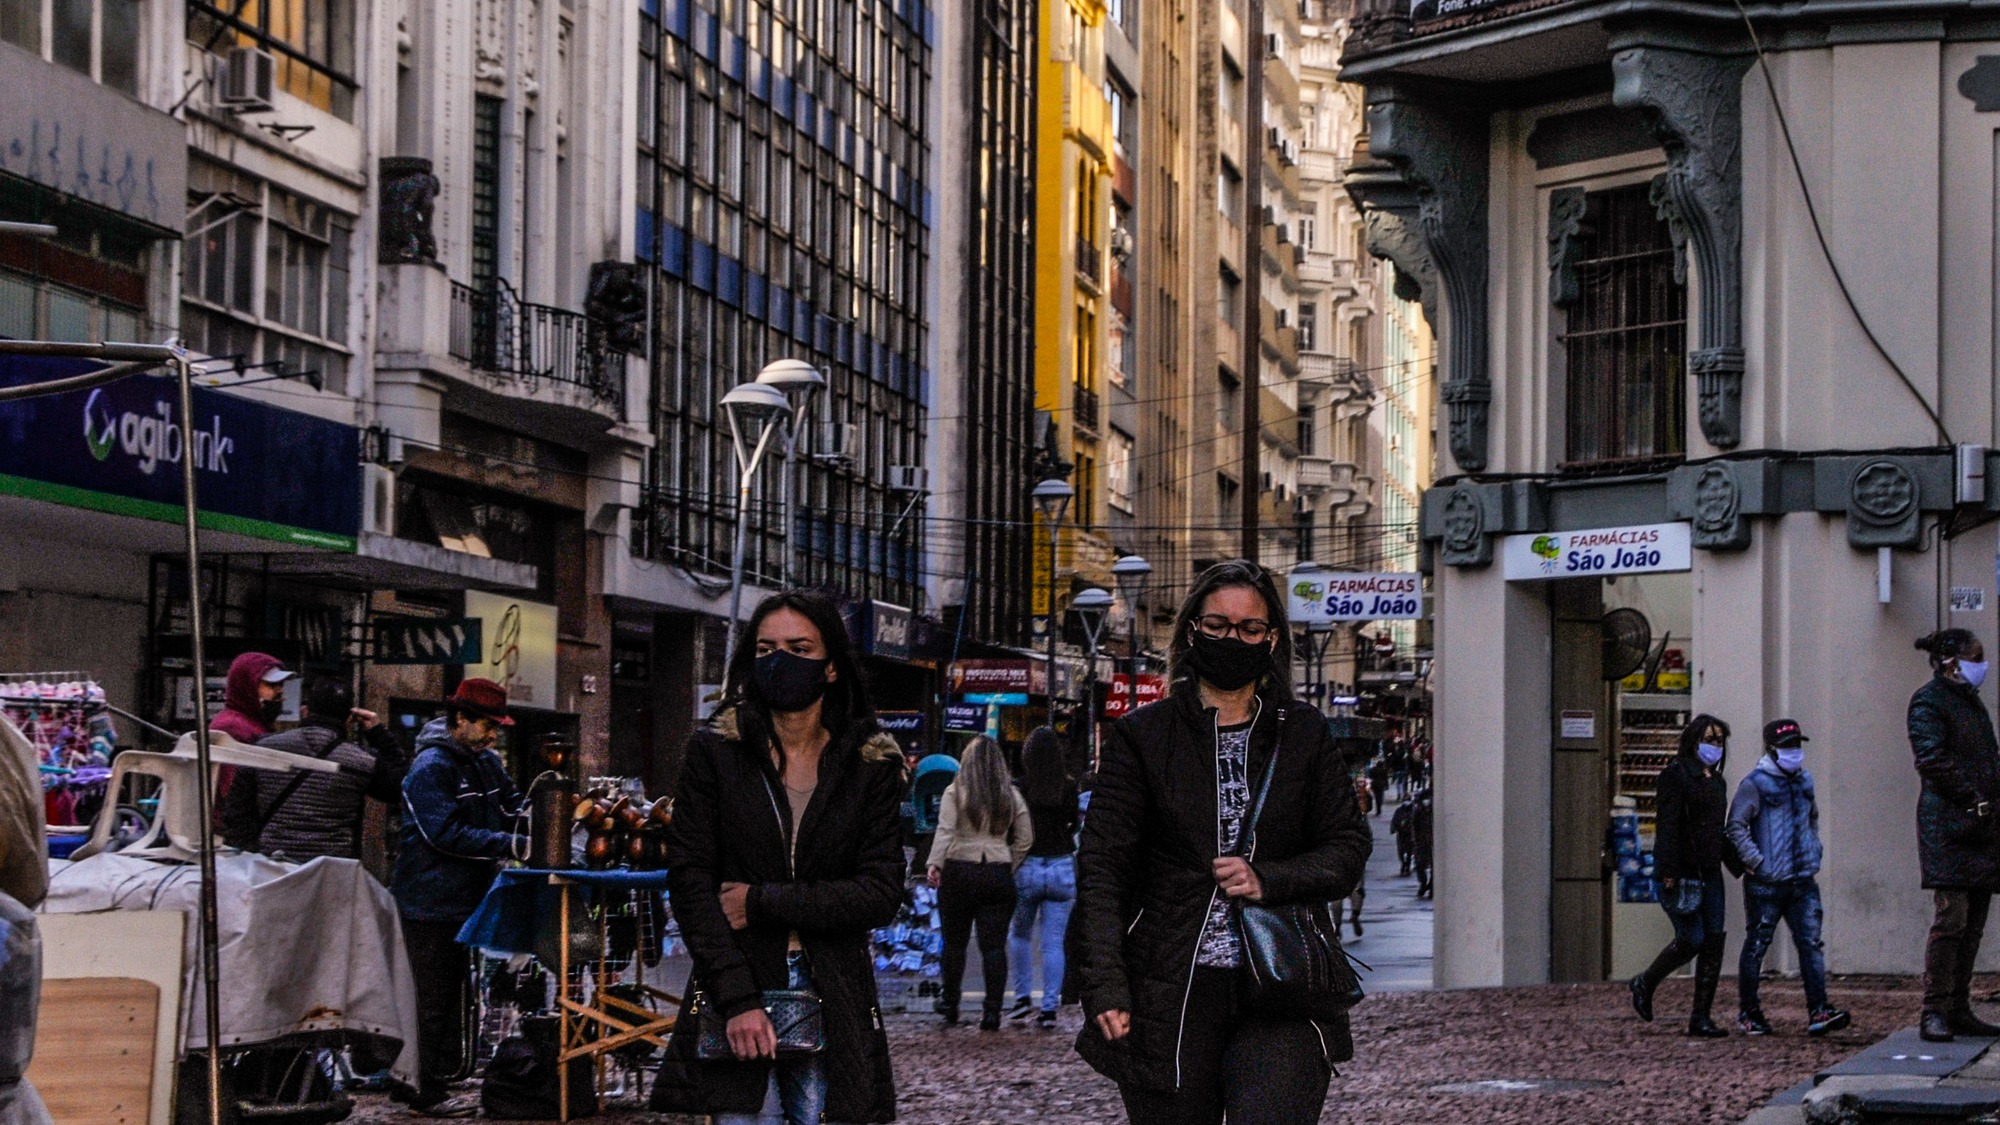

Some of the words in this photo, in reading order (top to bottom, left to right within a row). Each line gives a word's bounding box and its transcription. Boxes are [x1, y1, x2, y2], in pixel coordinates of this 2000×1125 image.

[120, 400, 234, 475] agibnk
[1570, 530, 1659, 548] FARMÁCIAS
[1566, 549, 1605, 572] São
[1611, 545, 1661, 569] João
[1329, 576, 1415, 593] FARMÁCIAS
[1325, 594, 1364, 615] São
[1369, 594, 1417, 615] João
